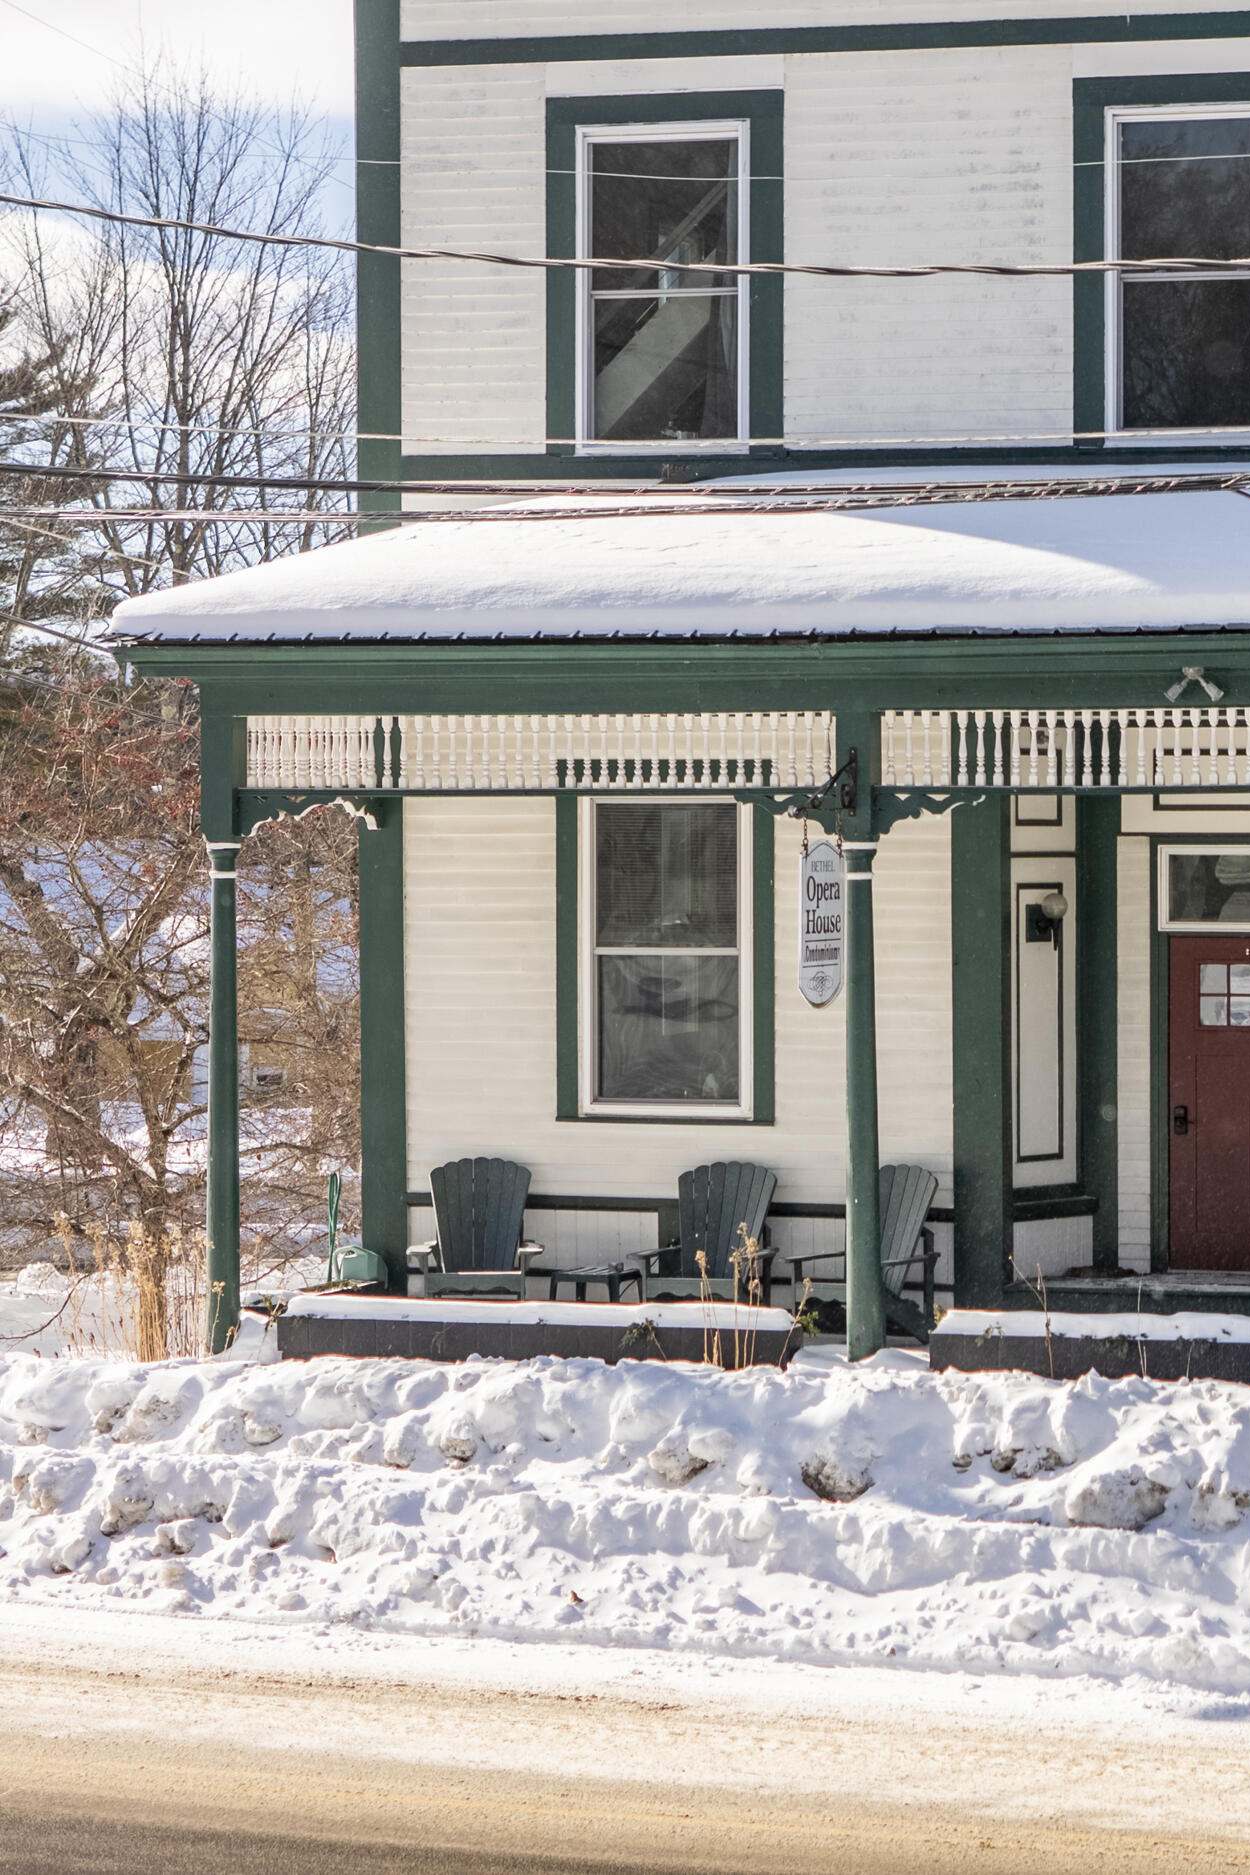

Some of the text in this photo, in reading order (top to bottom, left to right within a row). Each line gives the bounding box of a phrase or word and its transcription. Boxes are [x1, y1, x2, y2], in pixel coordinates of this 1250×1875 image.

[811, 860, 836, 873] BETHEL
[806, 875, 841, 909] Opera
[805, 909, 842, 935] House
